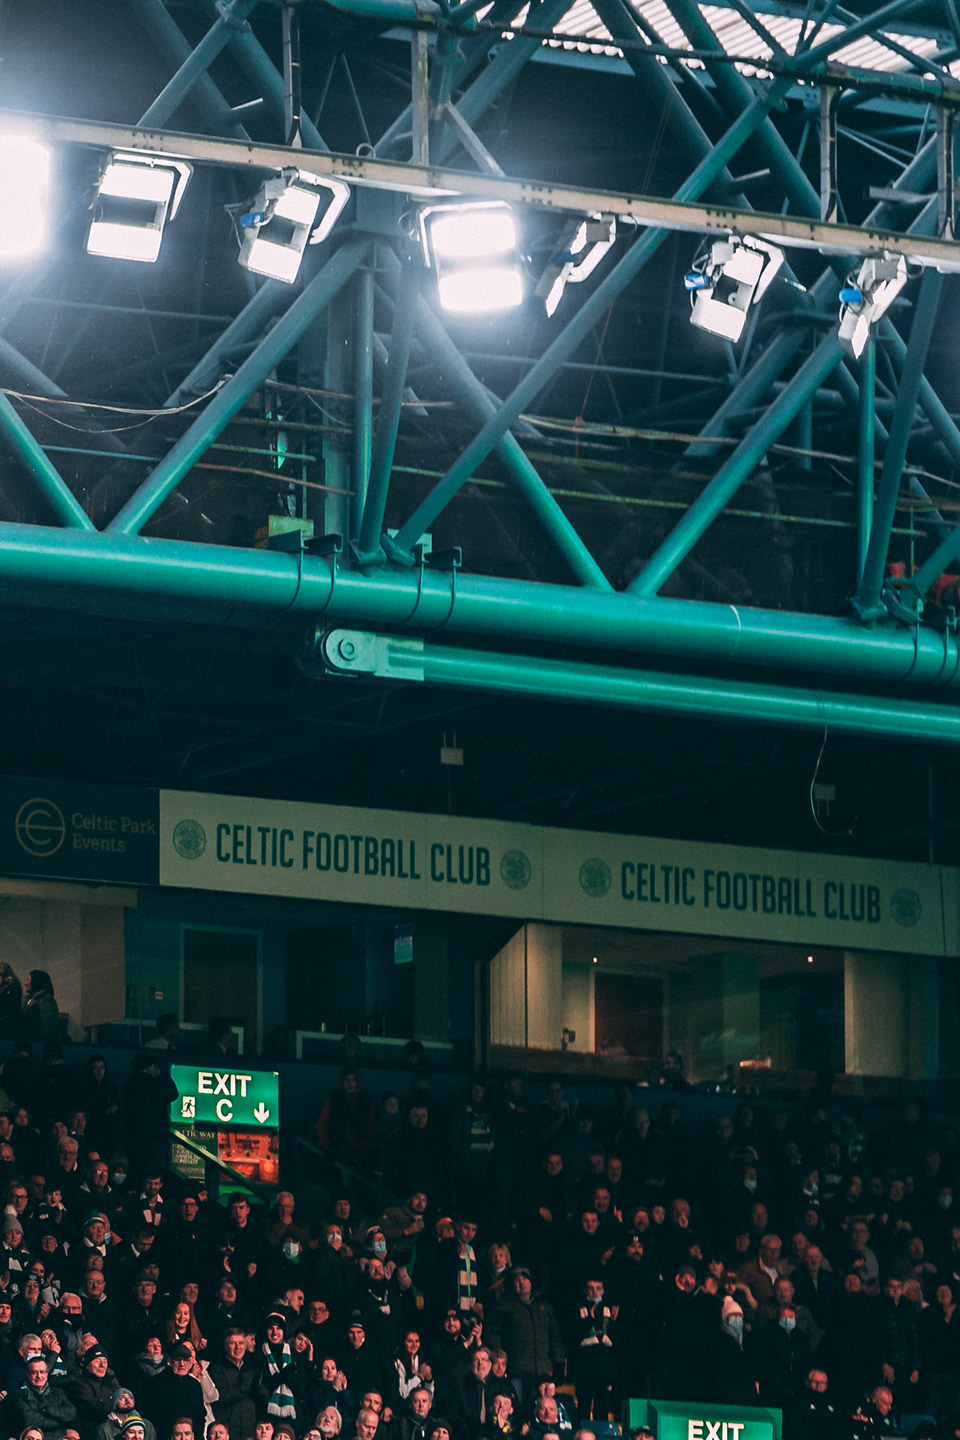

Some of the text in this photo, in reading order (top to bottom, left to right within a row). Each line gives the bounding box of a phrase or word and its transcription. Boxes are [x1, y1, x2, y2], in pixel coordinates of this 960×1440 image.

[71, 813, 157, 837] Celtic Park
[72, 833, 126, 853] Events
[215, 822, 491, 887] CELTIC FOOTBALL CLUB
[620, 861, 881, 925] CELTIC FOOTBALL CLUB
[197, 1071, 252, 1097] EXIT
[216, 1098, 233, 1122] C
